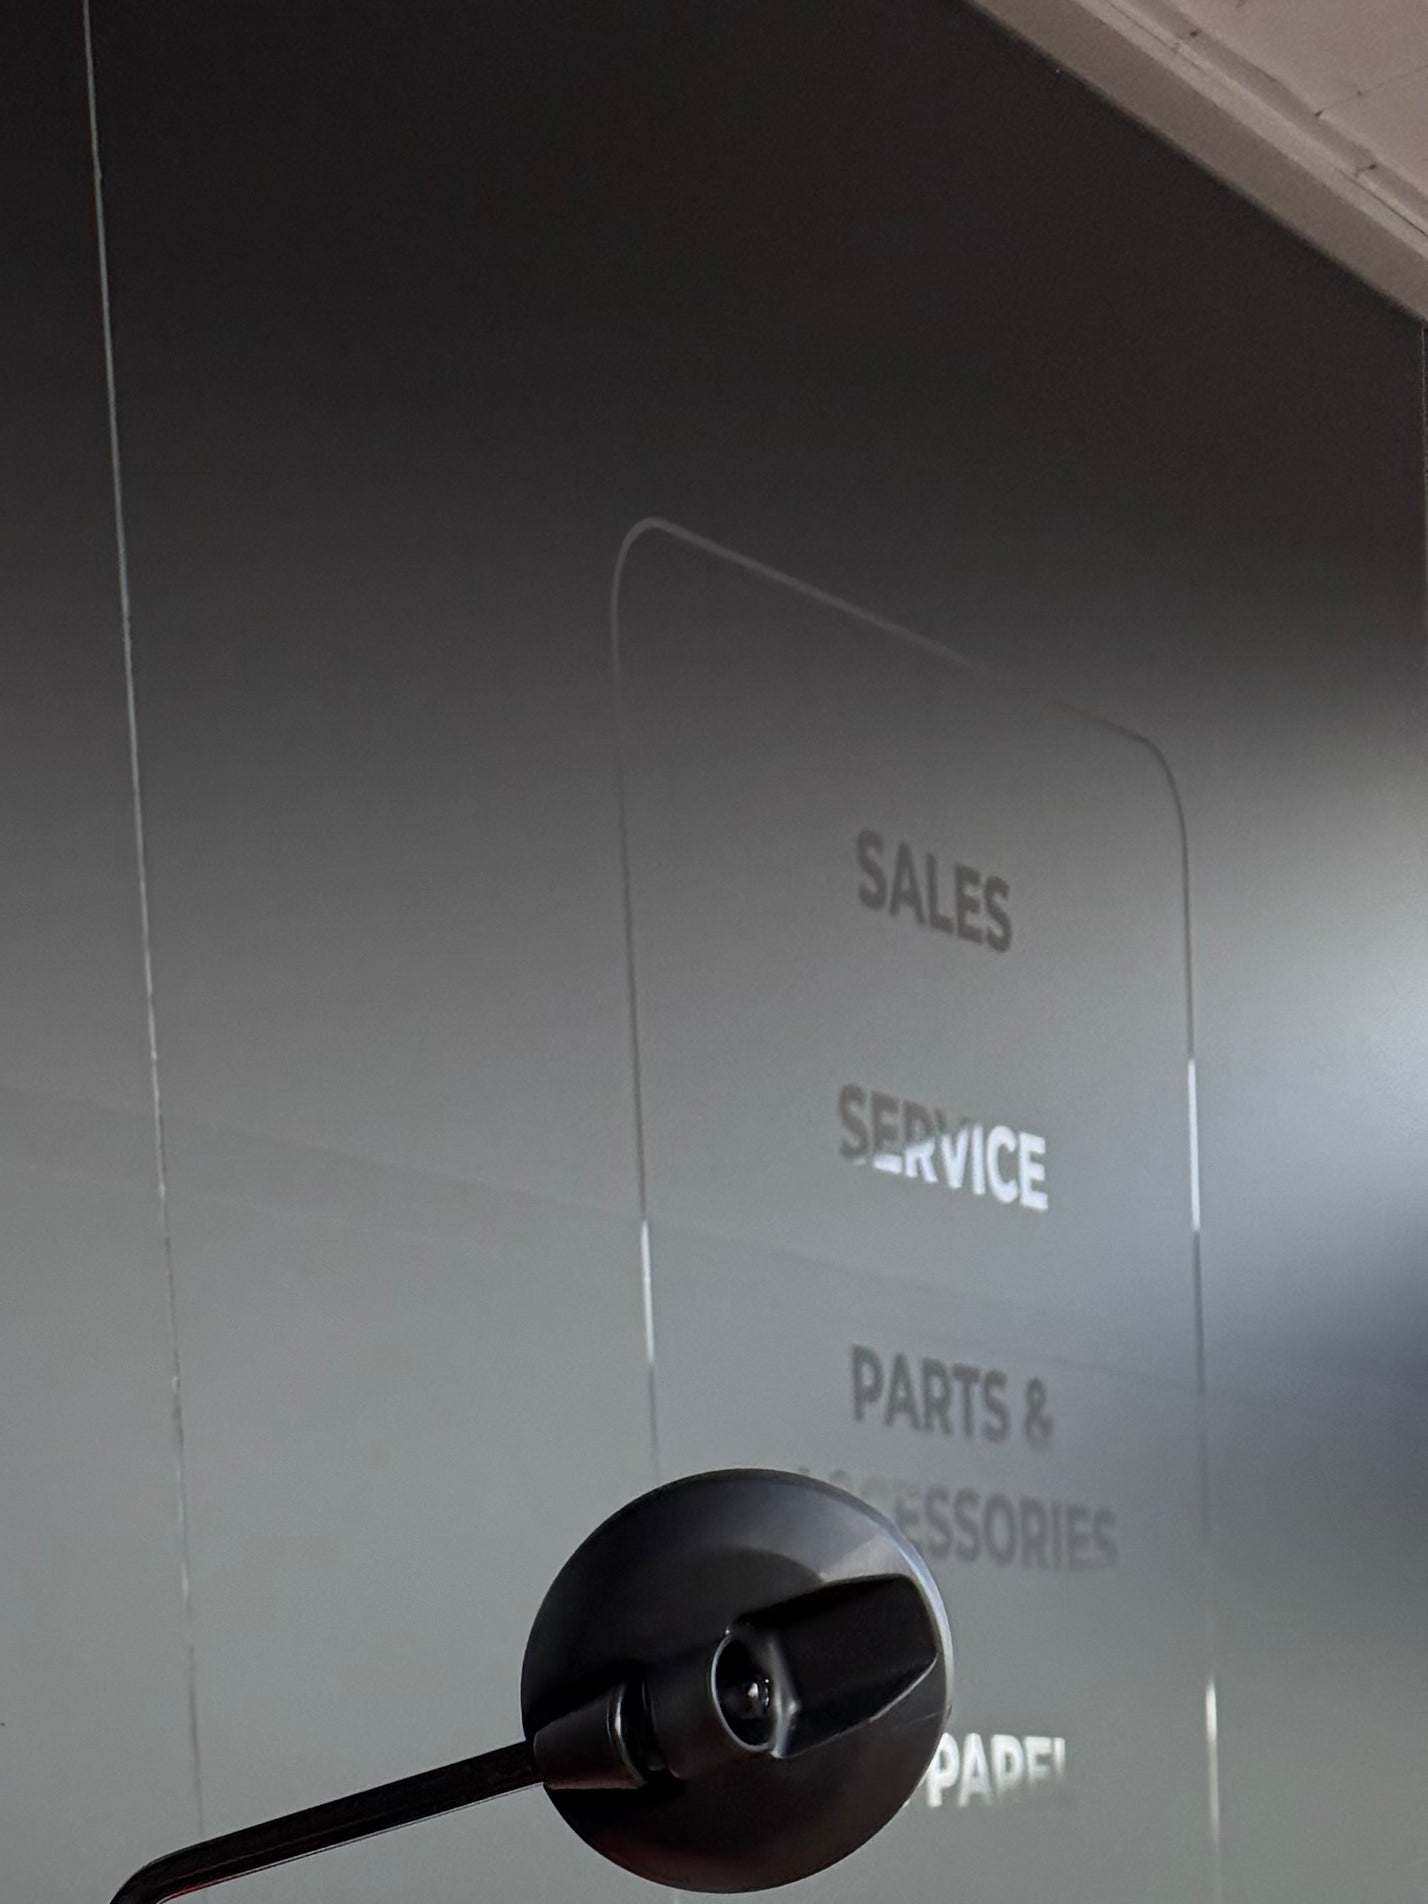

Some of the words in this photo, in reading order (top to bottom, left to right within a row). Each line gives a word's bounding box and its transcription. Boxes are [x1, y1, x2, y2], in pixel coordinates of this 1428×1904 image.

[853, 828, 1013, 955] SALES
[836, 1083, 1048, 1210] SERVICE
[850, 1343, 1011, 1446] PARTS
[1023, 1376, 1055, 1450] &
